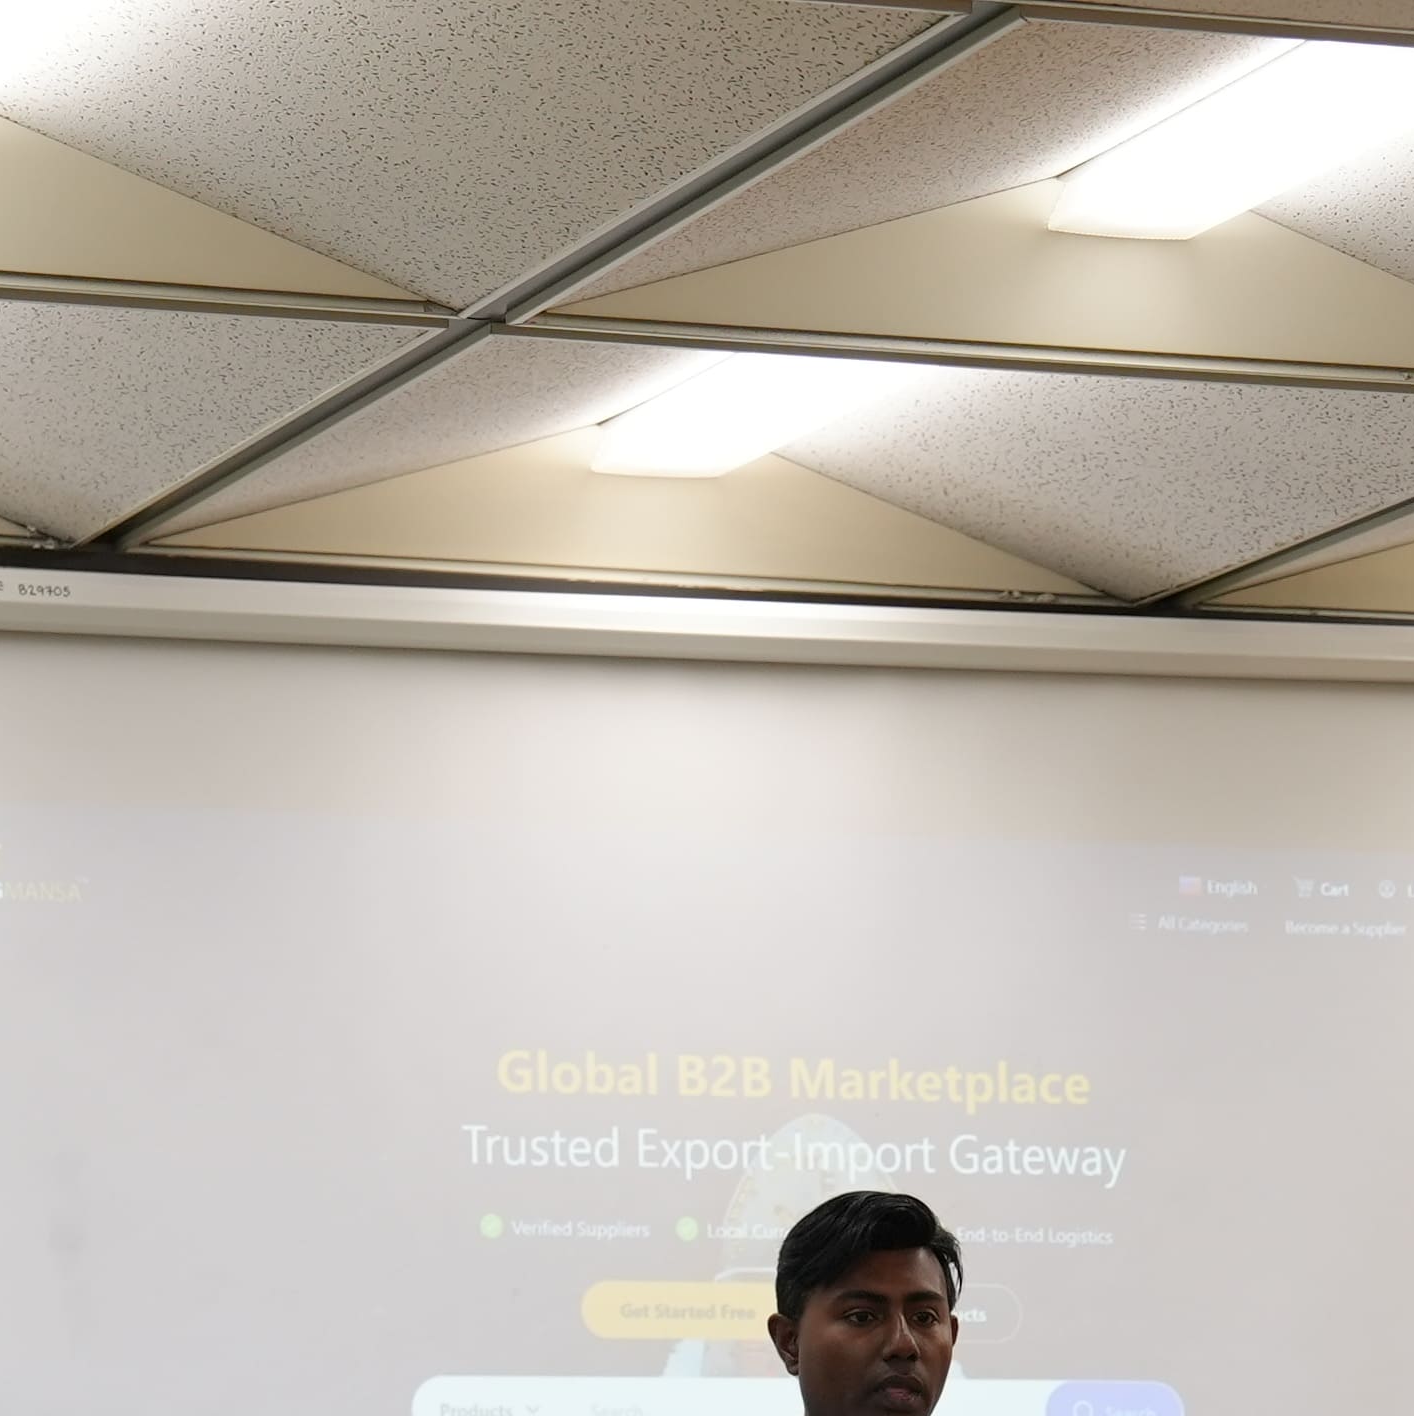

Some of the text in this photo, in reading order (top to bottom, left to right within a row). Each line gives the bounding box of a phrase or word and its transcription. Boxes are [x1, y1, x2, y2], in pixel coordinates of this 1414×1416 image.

[1207, 879, 1258, 899] English
[1320, 882, 1350, 898] Cart
[496, 1048, 1092, 1116] Global B2B Marketplace
[460, 1122, 1127, 1191] Trusted Export-Import Gateway
[509, 1217, 651, 1244] Verified Suppliers
[1048, 1227, 1115, 1248] Logistics
[620, 1302, 756, 1321] Get Started Free
